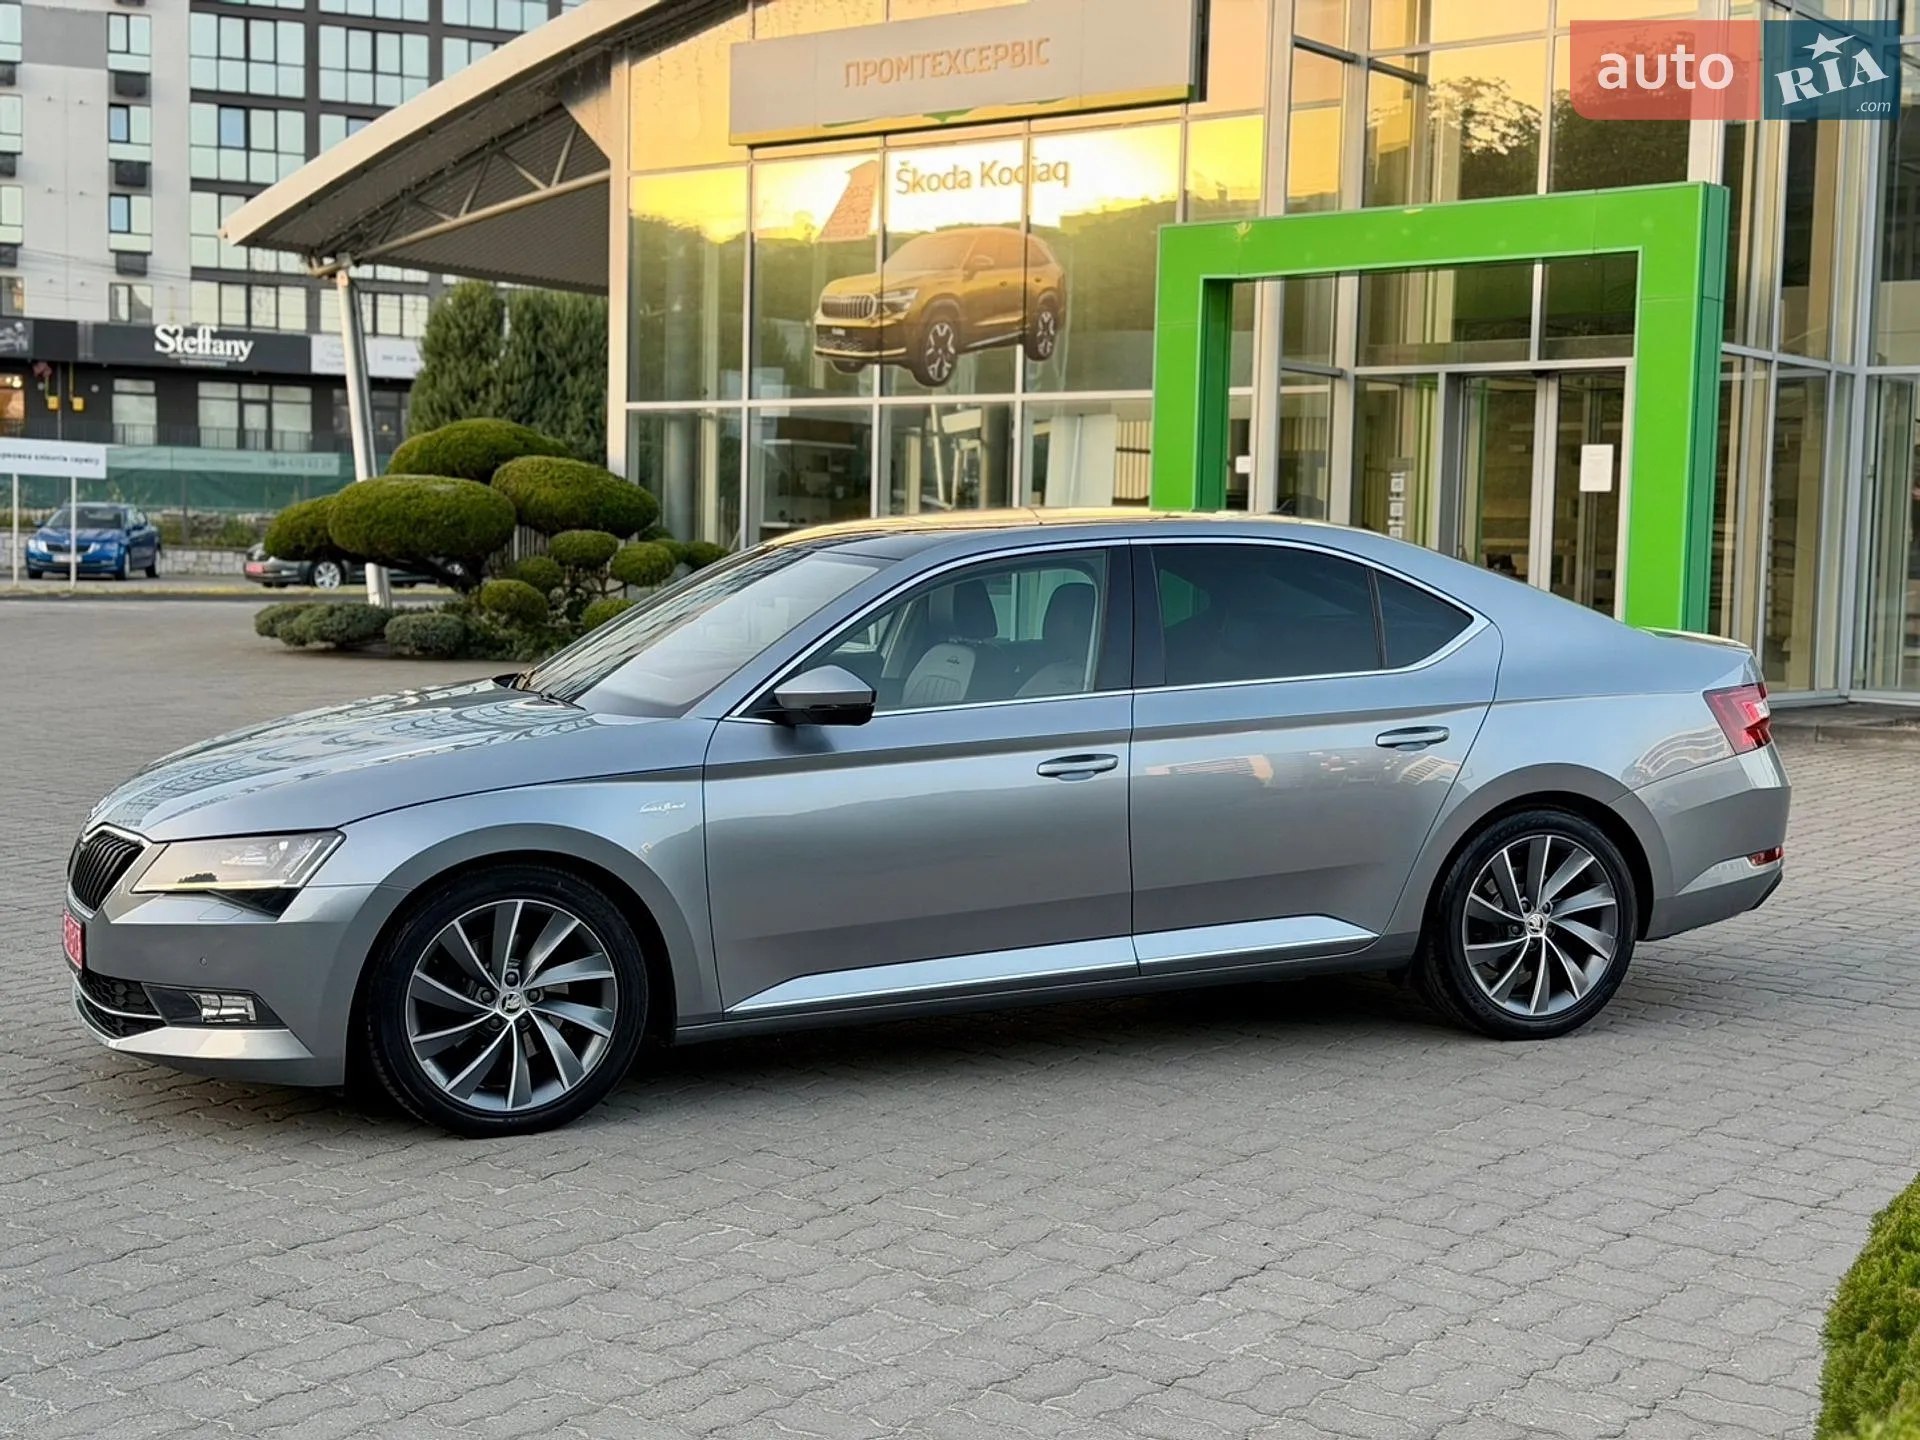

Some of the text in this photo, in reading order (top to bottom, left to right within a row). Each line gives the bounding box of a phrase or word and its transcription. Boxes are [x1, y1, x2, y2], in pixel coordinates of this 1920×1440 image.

[844, 37, 1051, 88] ПРОМТЕХСЕРВІС
[895, 156, 1069, 195] Škoda Kodiaq
[153, 323, 255, 362] Steffany
